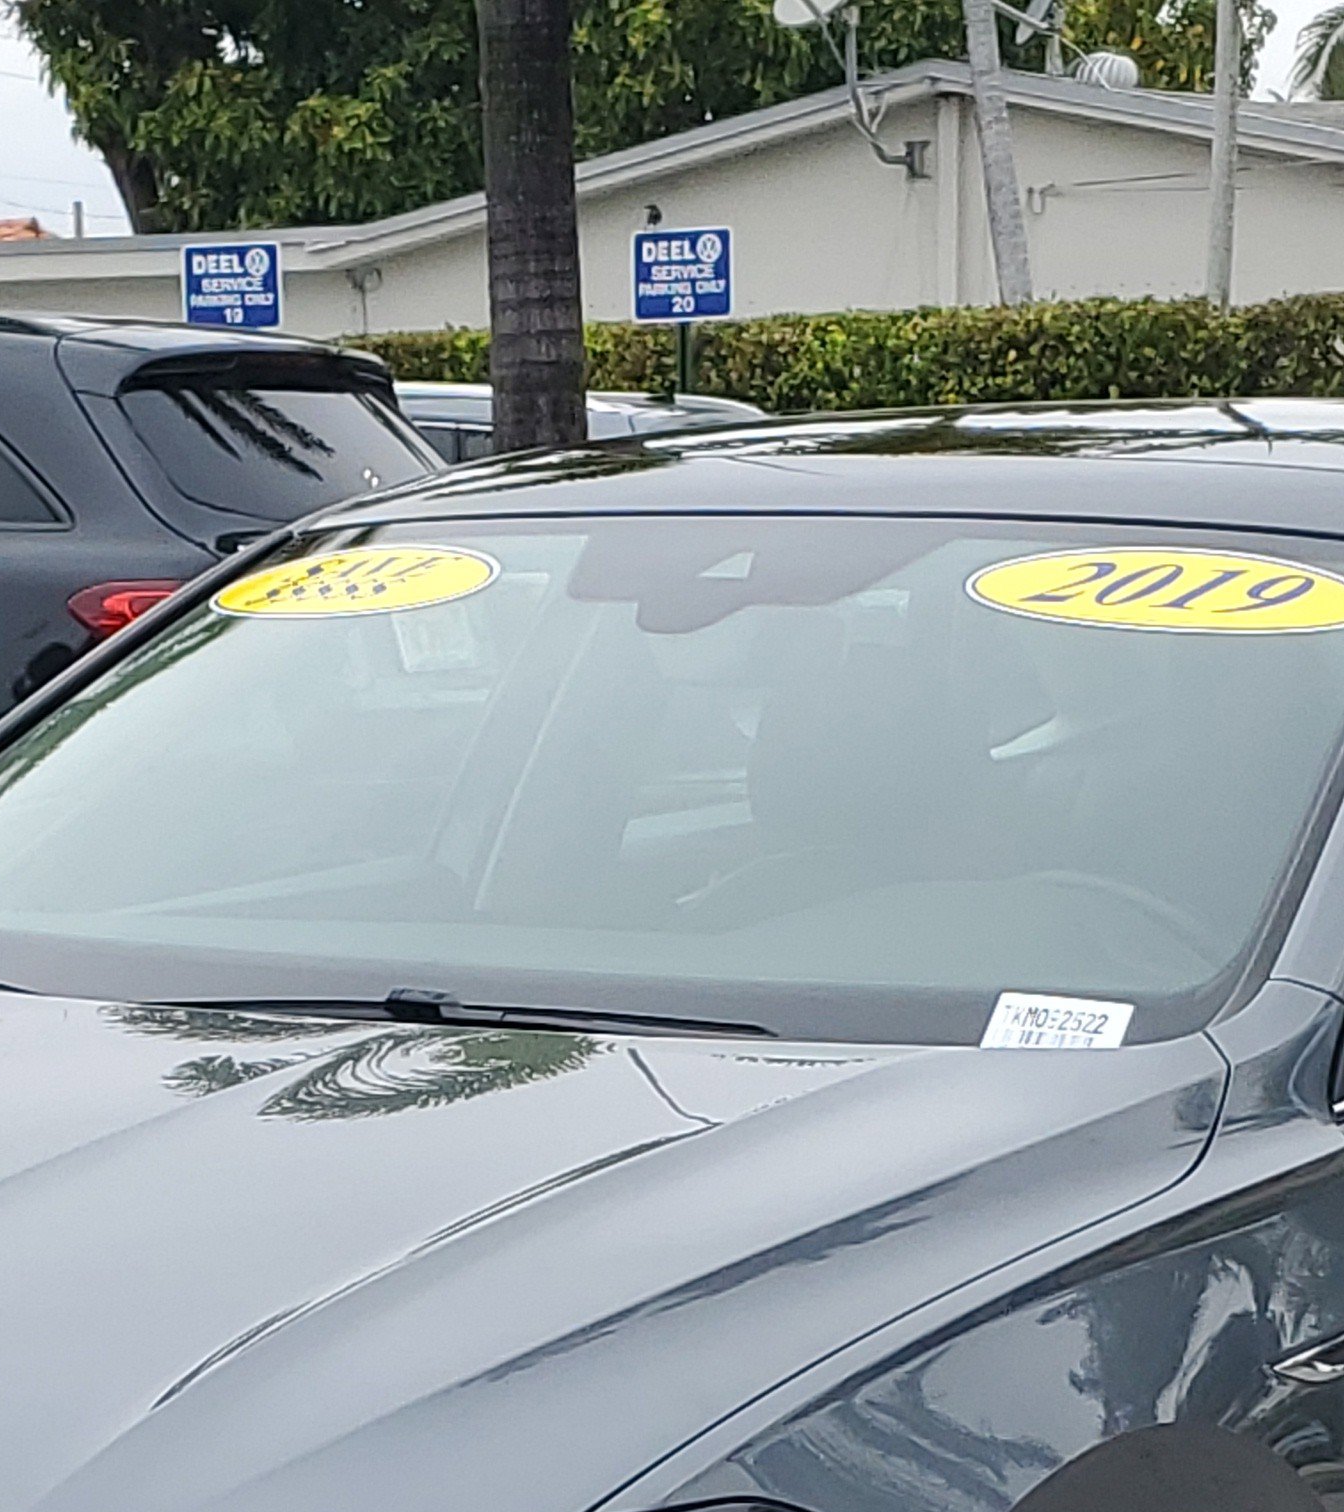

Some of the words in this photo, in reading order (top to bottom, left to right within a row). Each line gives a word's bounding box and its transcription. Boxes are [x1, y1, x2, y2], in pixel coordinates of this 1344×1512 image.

[642, 239, 696, 263] DEEL
[192, 254, 244, 275] DEEL
[651, 263, 715, 281] SERVICE
[201, 276, 264, 293] SERVICE
[638, 281, 692, 298] PARKING
[695, 279, 726, 294] ONLY
[190, 293, 242, 309] PARKING
[244, 292, 275, 306] ONLY
[671, 296, 695, 313] 20
[223, 307, 244, 324] 19
[1018, 561, 1316, 614] 2019
